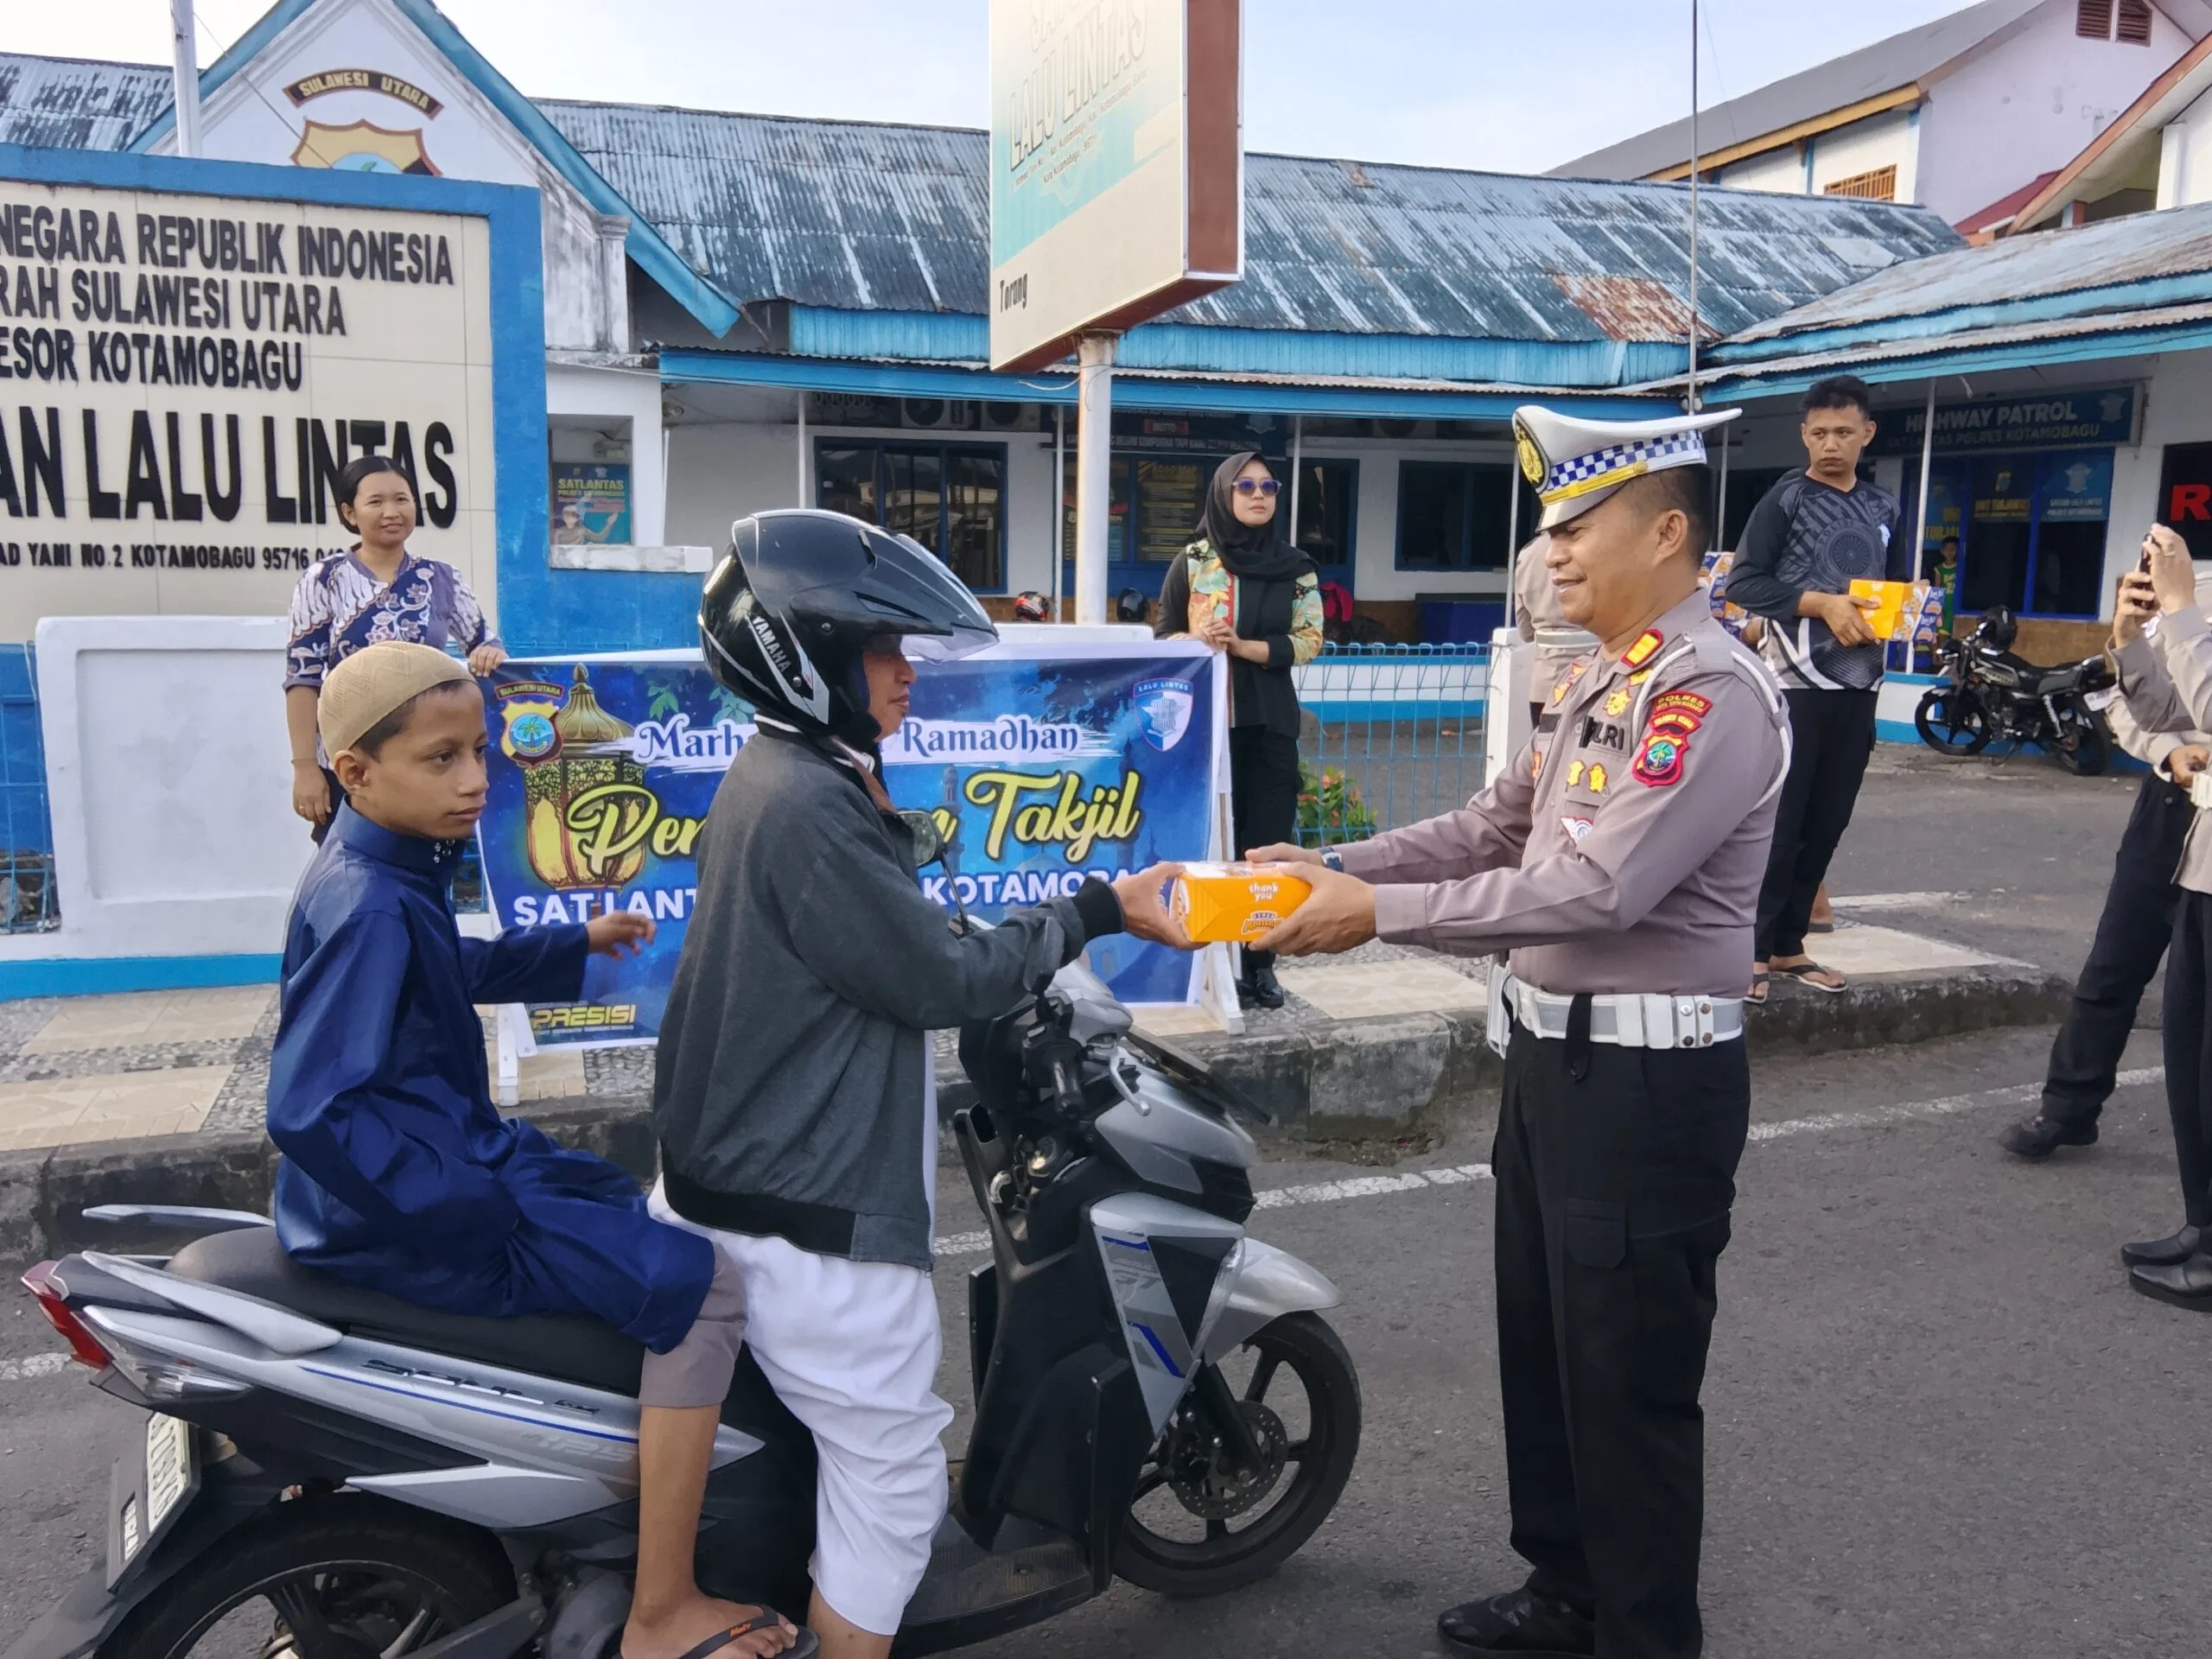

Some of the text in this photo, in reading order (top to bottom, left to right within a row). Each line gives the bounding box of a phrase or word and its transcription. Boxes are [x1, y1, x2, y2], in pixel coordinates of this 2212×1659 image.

[298, 71, 431, 109] SULAWESI UTARA
[137, 213, 287, 274] REPUBLIK
[298, 226, 453, 286] INDONESIA
[72, 269, 229, 329] SULAWESI
[241, 282, 346, 336] UTARA
[88, 330, 302, 391] KOTAMOBAGU
[1905, 400, 2079, 433] HIHWAY PATROL
[82, 408, 242, 522] LALU
[558, 479, 624, 490] SATLANTAS
[130, 544, 256, 569] KOTAMOBAGU
[262, 547, 308, 570] 95716
[751, 613, 792, 674] YAMAHA
[500, 683, 561, 696] SULAWESI UTARA
[1160, 681, 1189, 691] LINTAS
[903, 718, 1078, 758] Ramadhan
[963, 771, 1141, 862] Takjil
[1249, 882, 1279, 893] thank
[1255, 891, 1273, 902] you
[532, 1004, 637, 1029] PRESISI
